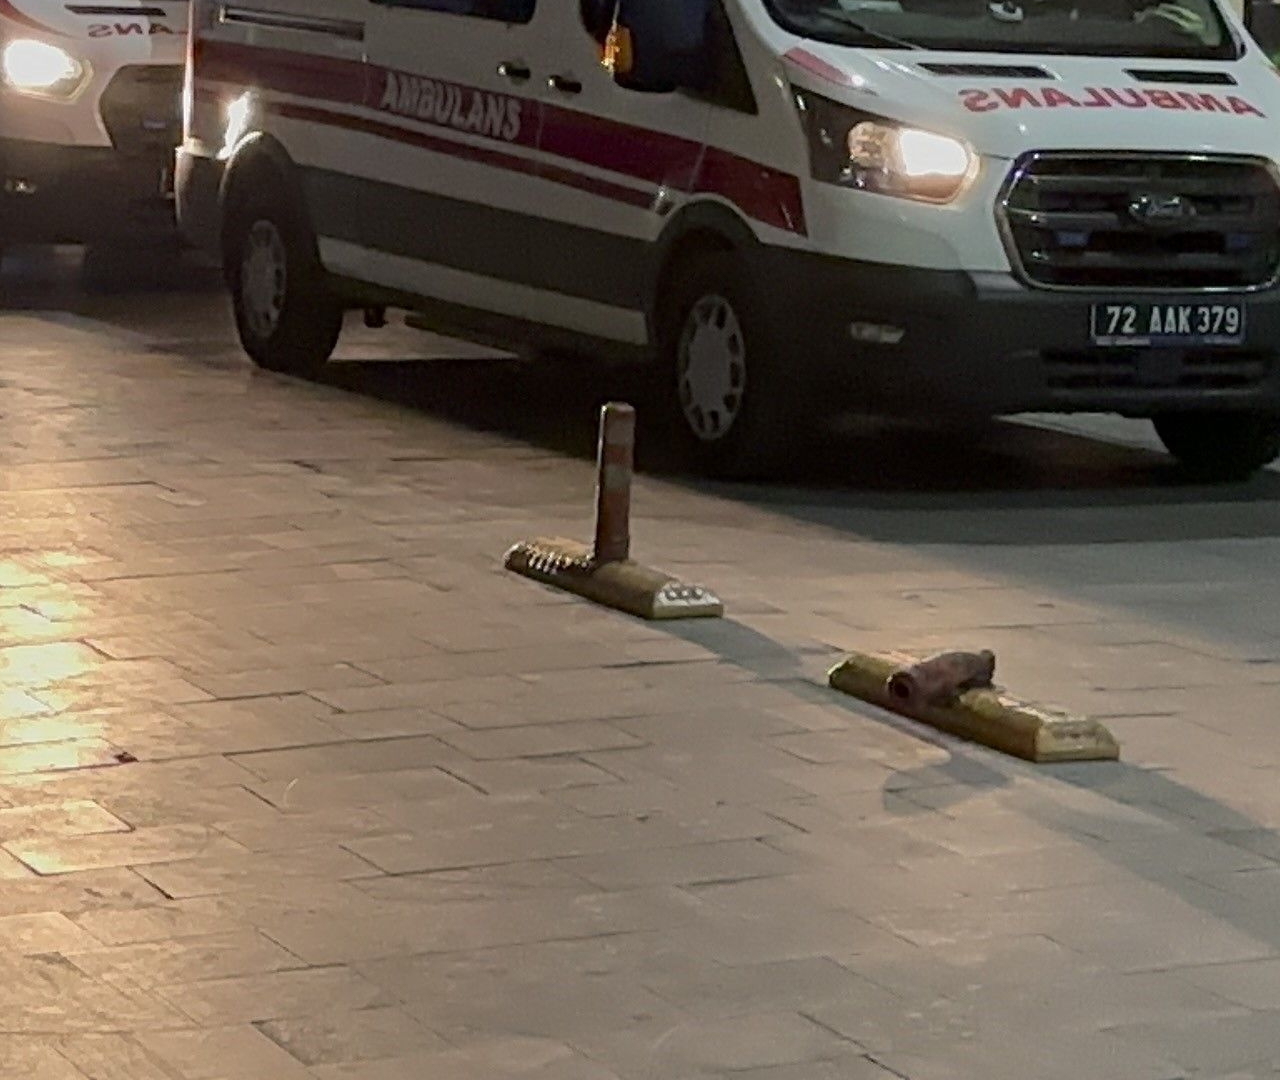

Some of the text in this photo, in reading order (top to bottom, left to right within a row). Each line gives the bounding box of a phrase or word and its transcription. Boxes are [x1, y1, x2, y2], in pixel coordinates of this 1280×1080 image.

[379, 71, 521, 141] AMBULANS
[1106, 305, 1240, 334] 72 AAK 379
